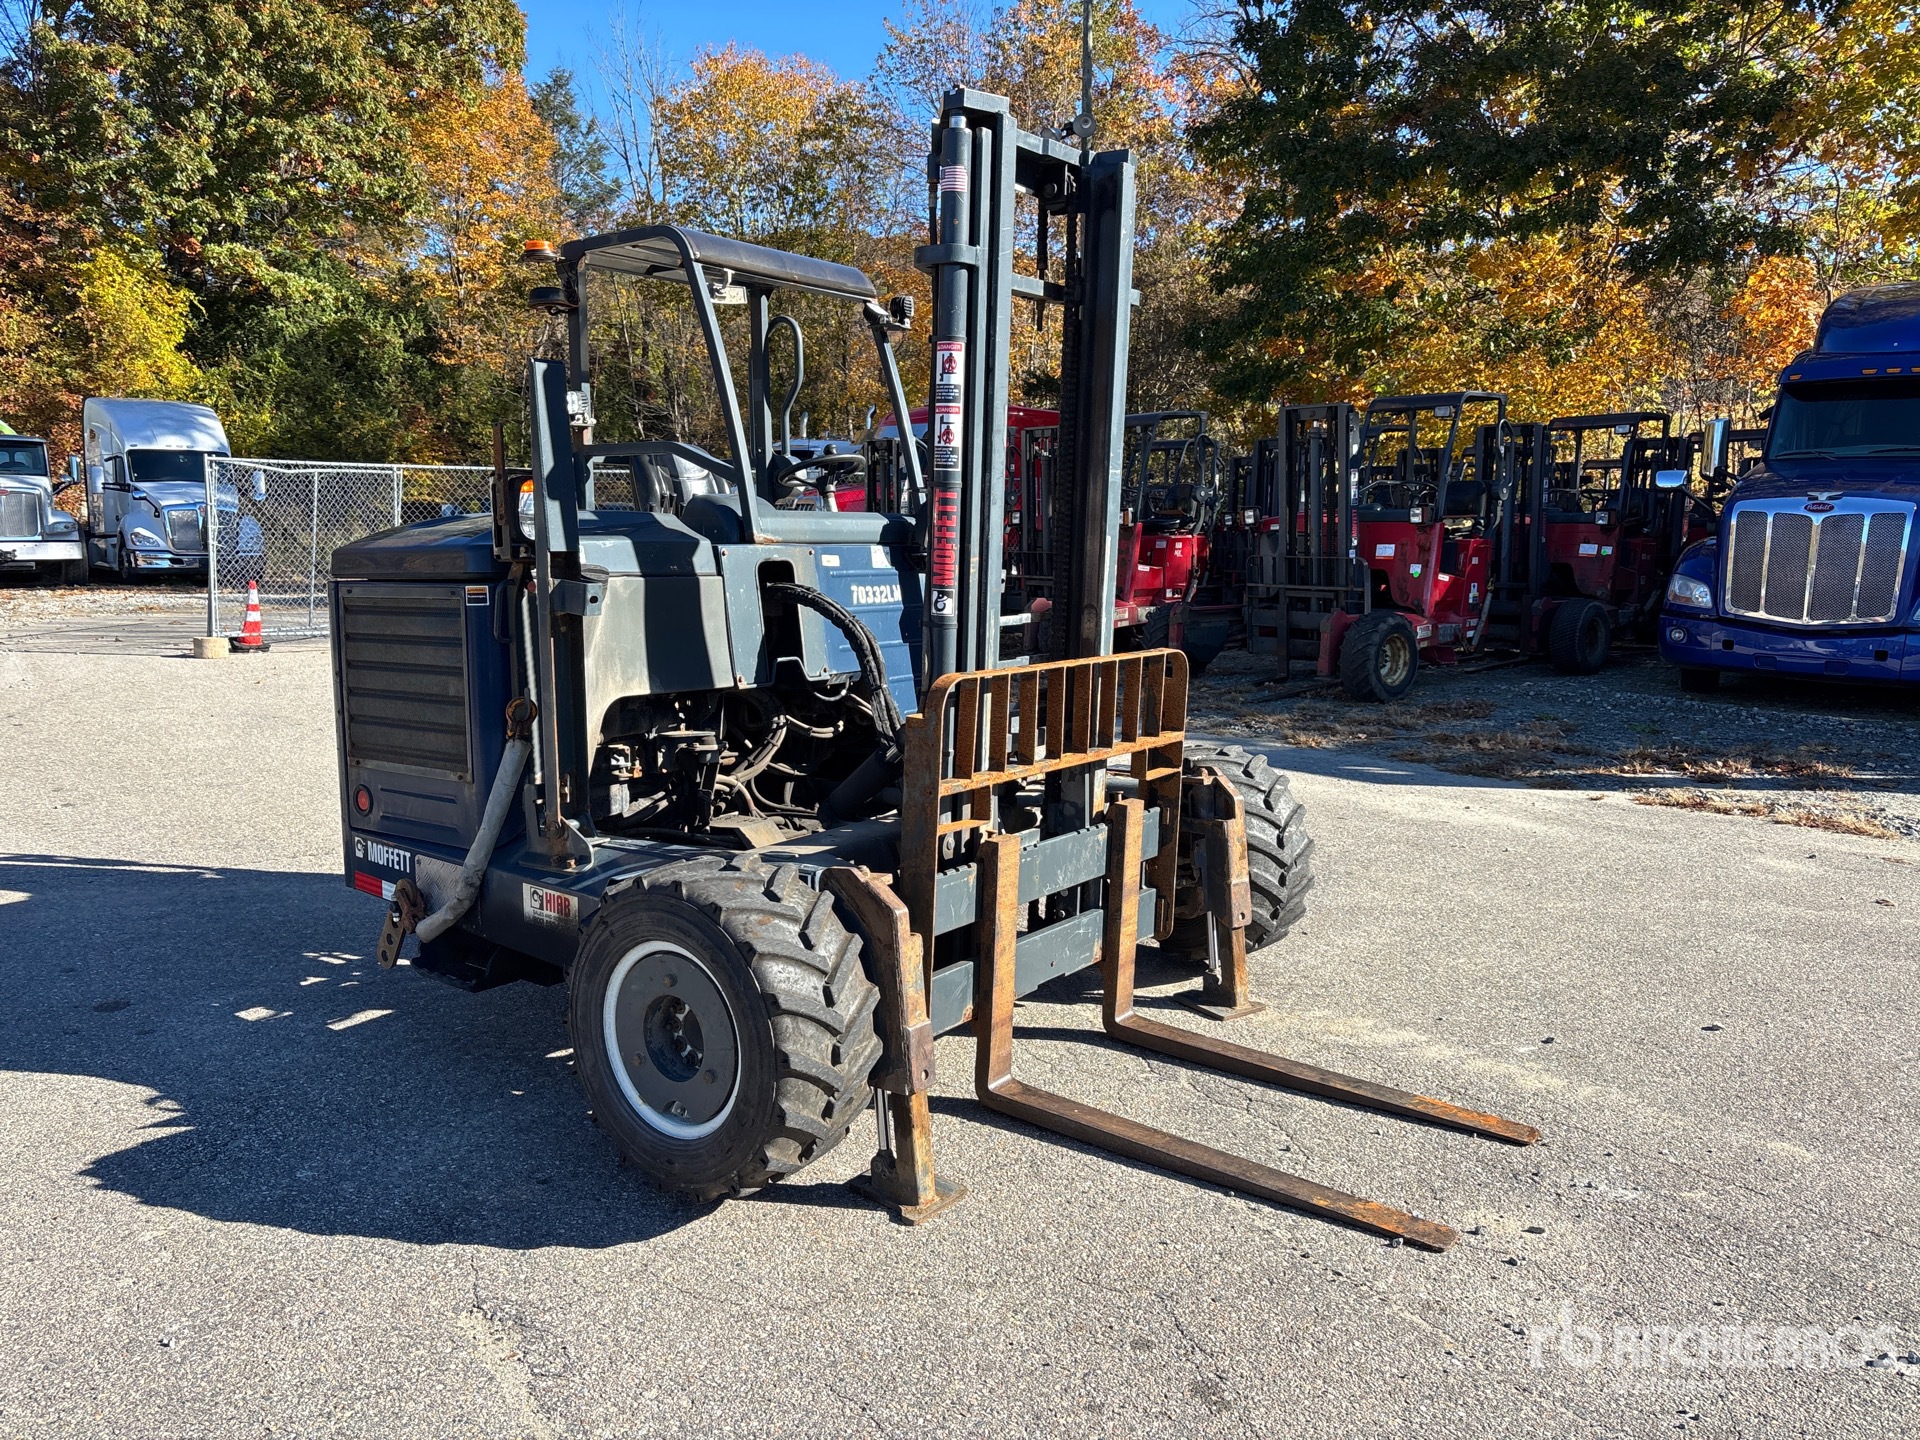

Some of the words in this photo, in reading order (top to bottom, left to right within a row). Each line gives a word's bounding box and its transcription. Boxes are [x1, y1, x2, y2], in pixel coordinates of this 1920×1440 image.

[932, 488, 957, 586] MOFFETT
[367, 840, 411, 874] MOFFETT
[544, 891, 571, 918] HIAB
